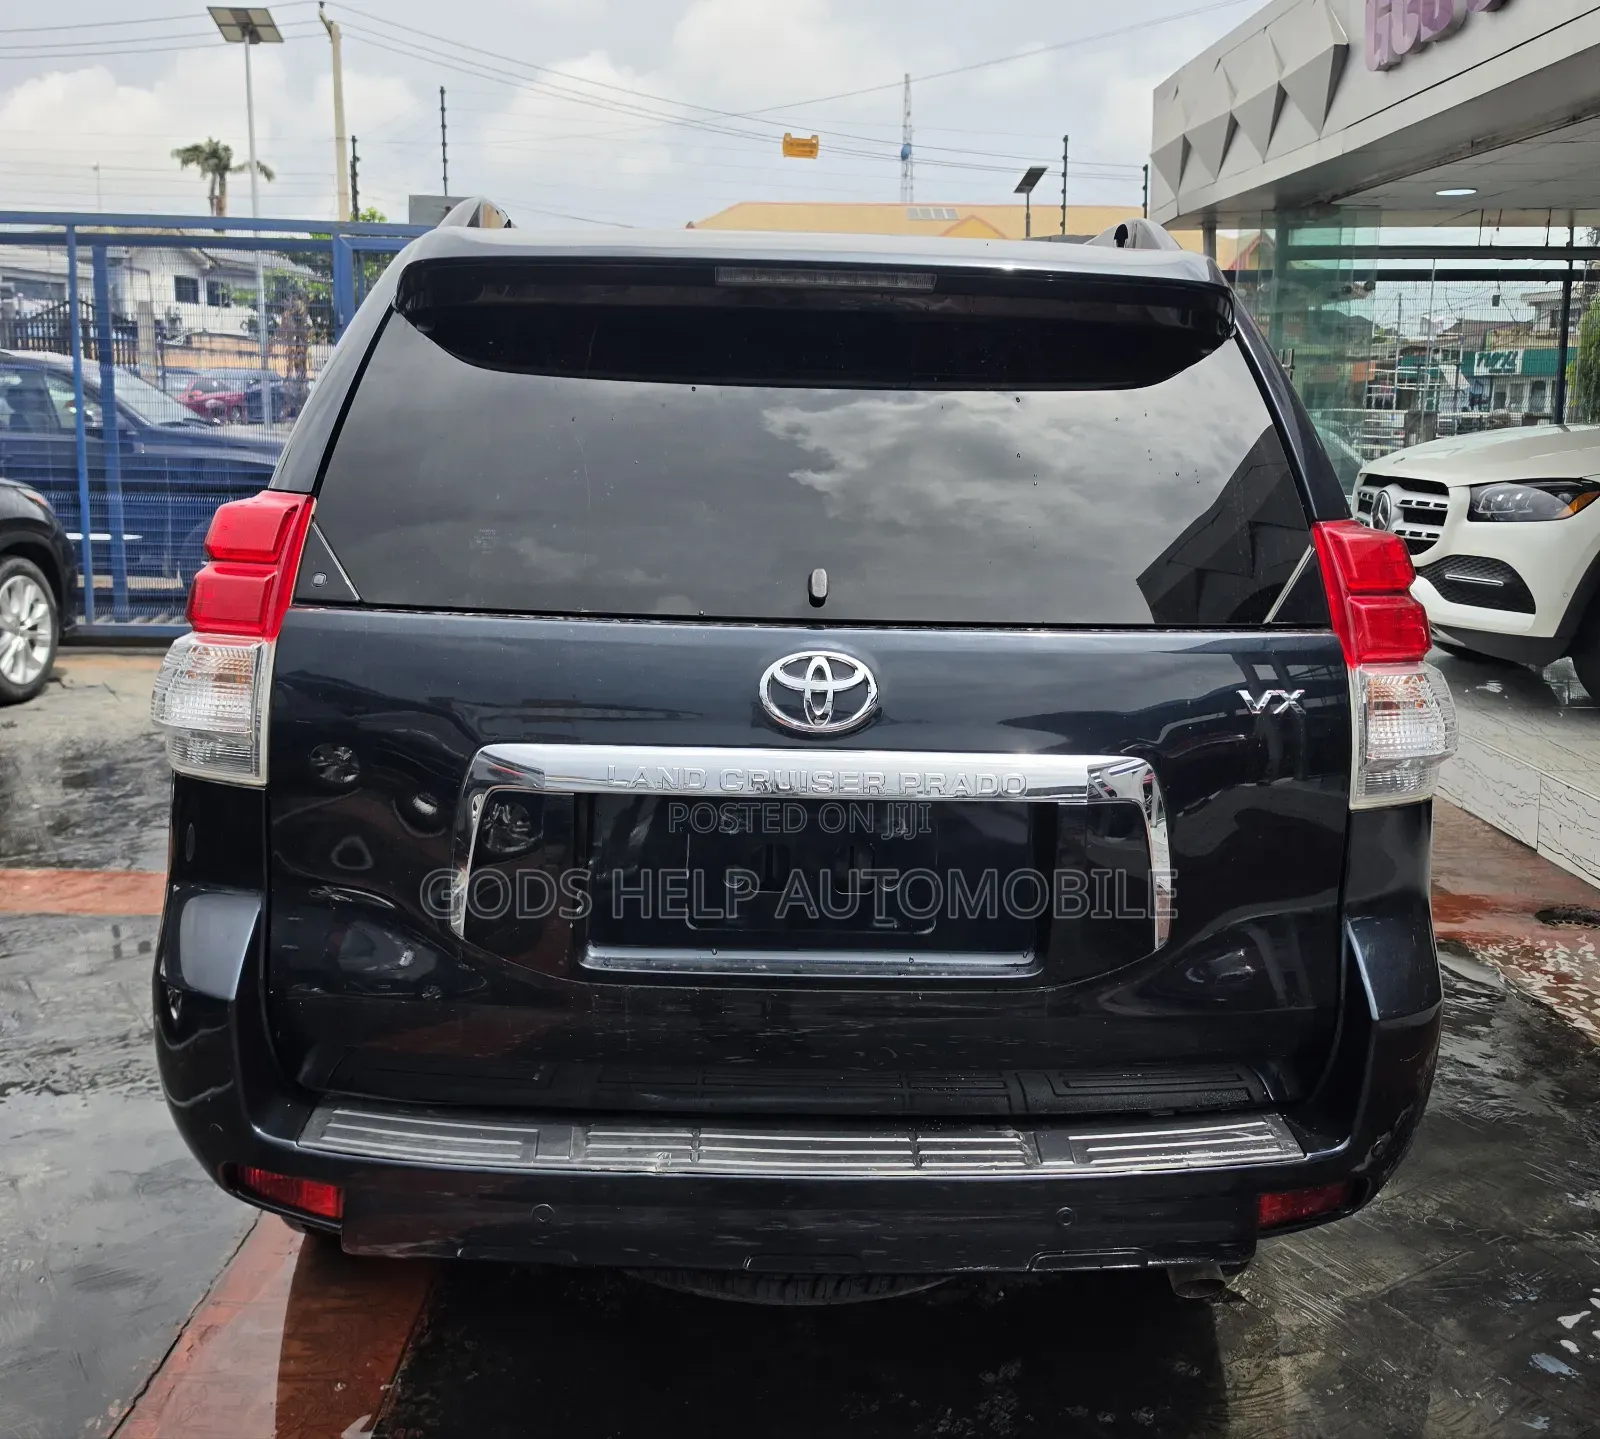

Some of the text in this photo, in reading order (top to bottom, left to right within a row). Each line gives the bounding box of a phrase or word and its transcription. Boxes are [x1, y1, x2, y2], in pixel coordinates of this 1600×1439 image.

[1236, 689, 1306, 715] VX
[607, 765, 1028, 797] LAND CRUISER PRADO
